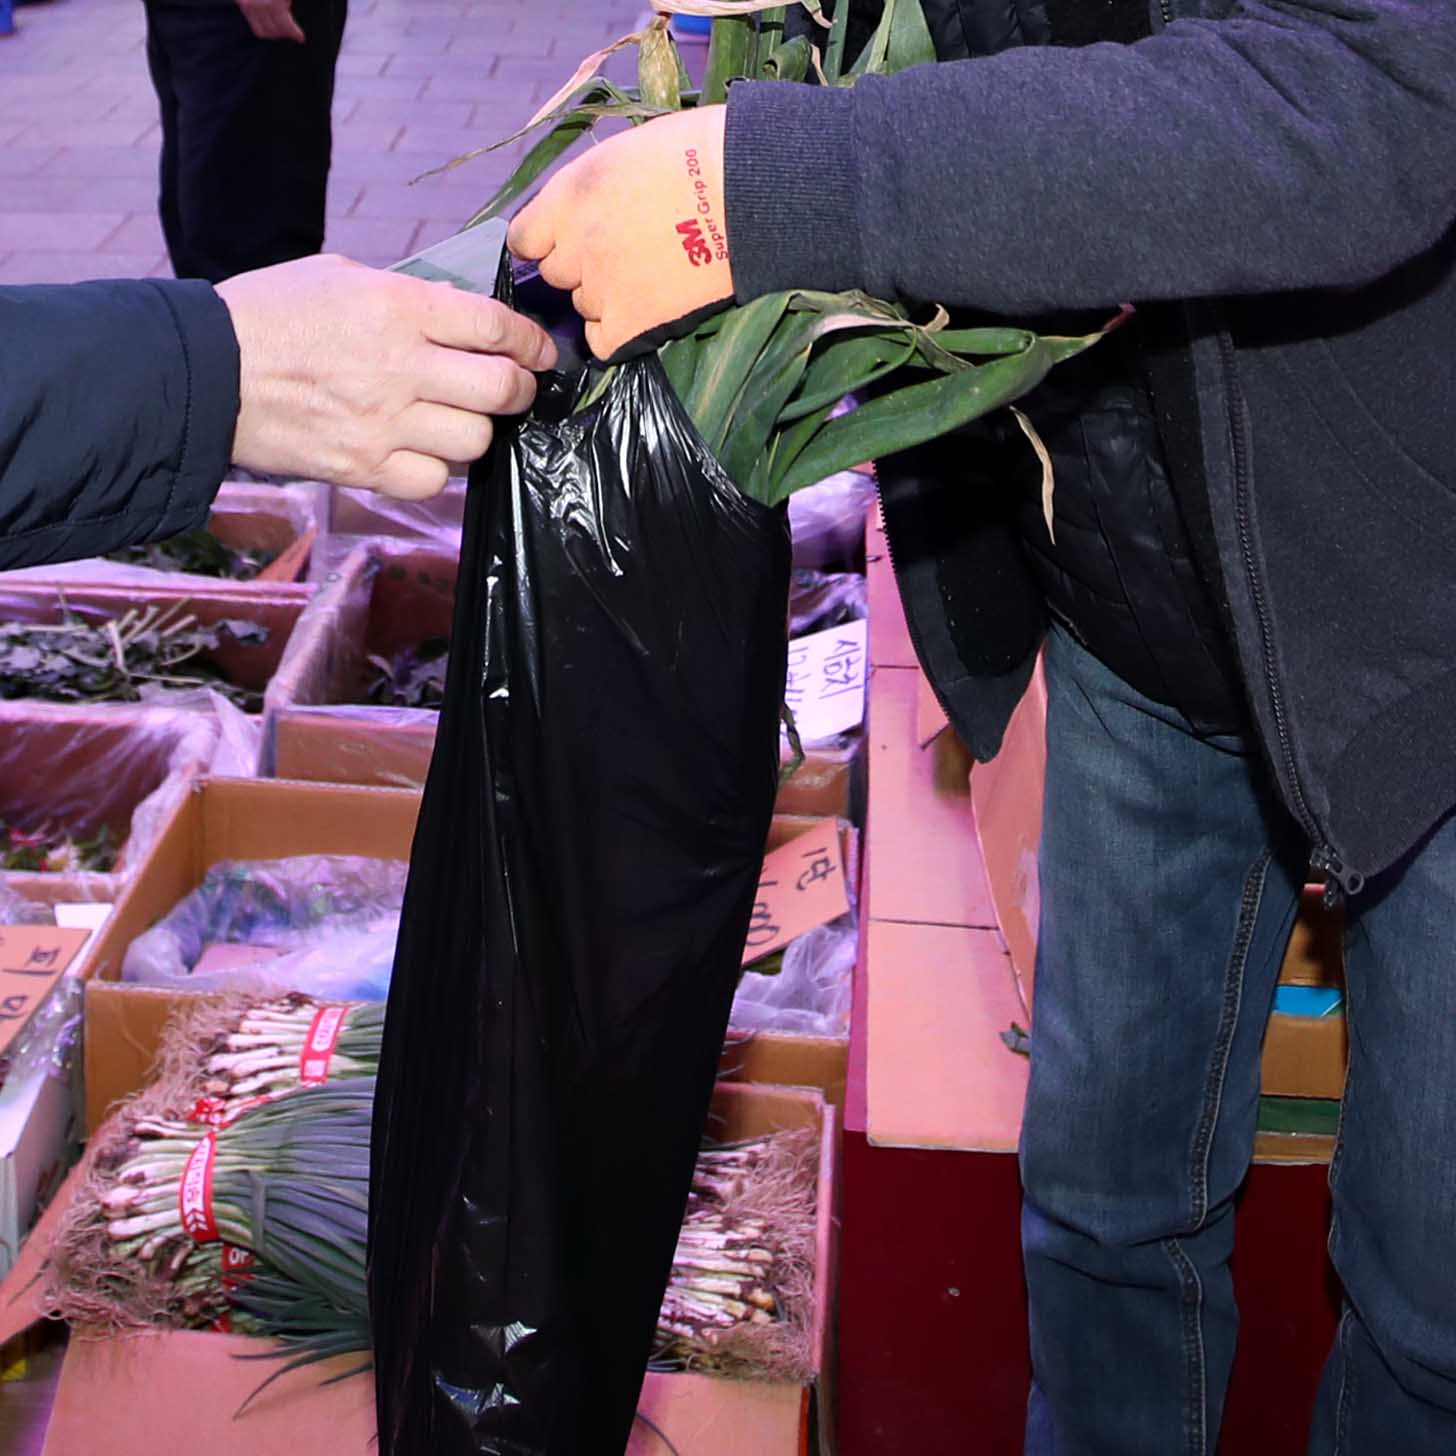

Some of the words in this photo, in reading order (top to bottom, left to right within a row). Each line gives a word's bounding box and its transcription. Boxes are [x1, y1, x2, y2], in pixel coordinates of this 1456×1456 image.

[684, 148, 702, 177] 200
[693, 180, 711, 215] Grip
[675, 218, 713, 267] 3M
[704, 217, 730, 261] Super
[820, 639, 865, 701] 시금치
